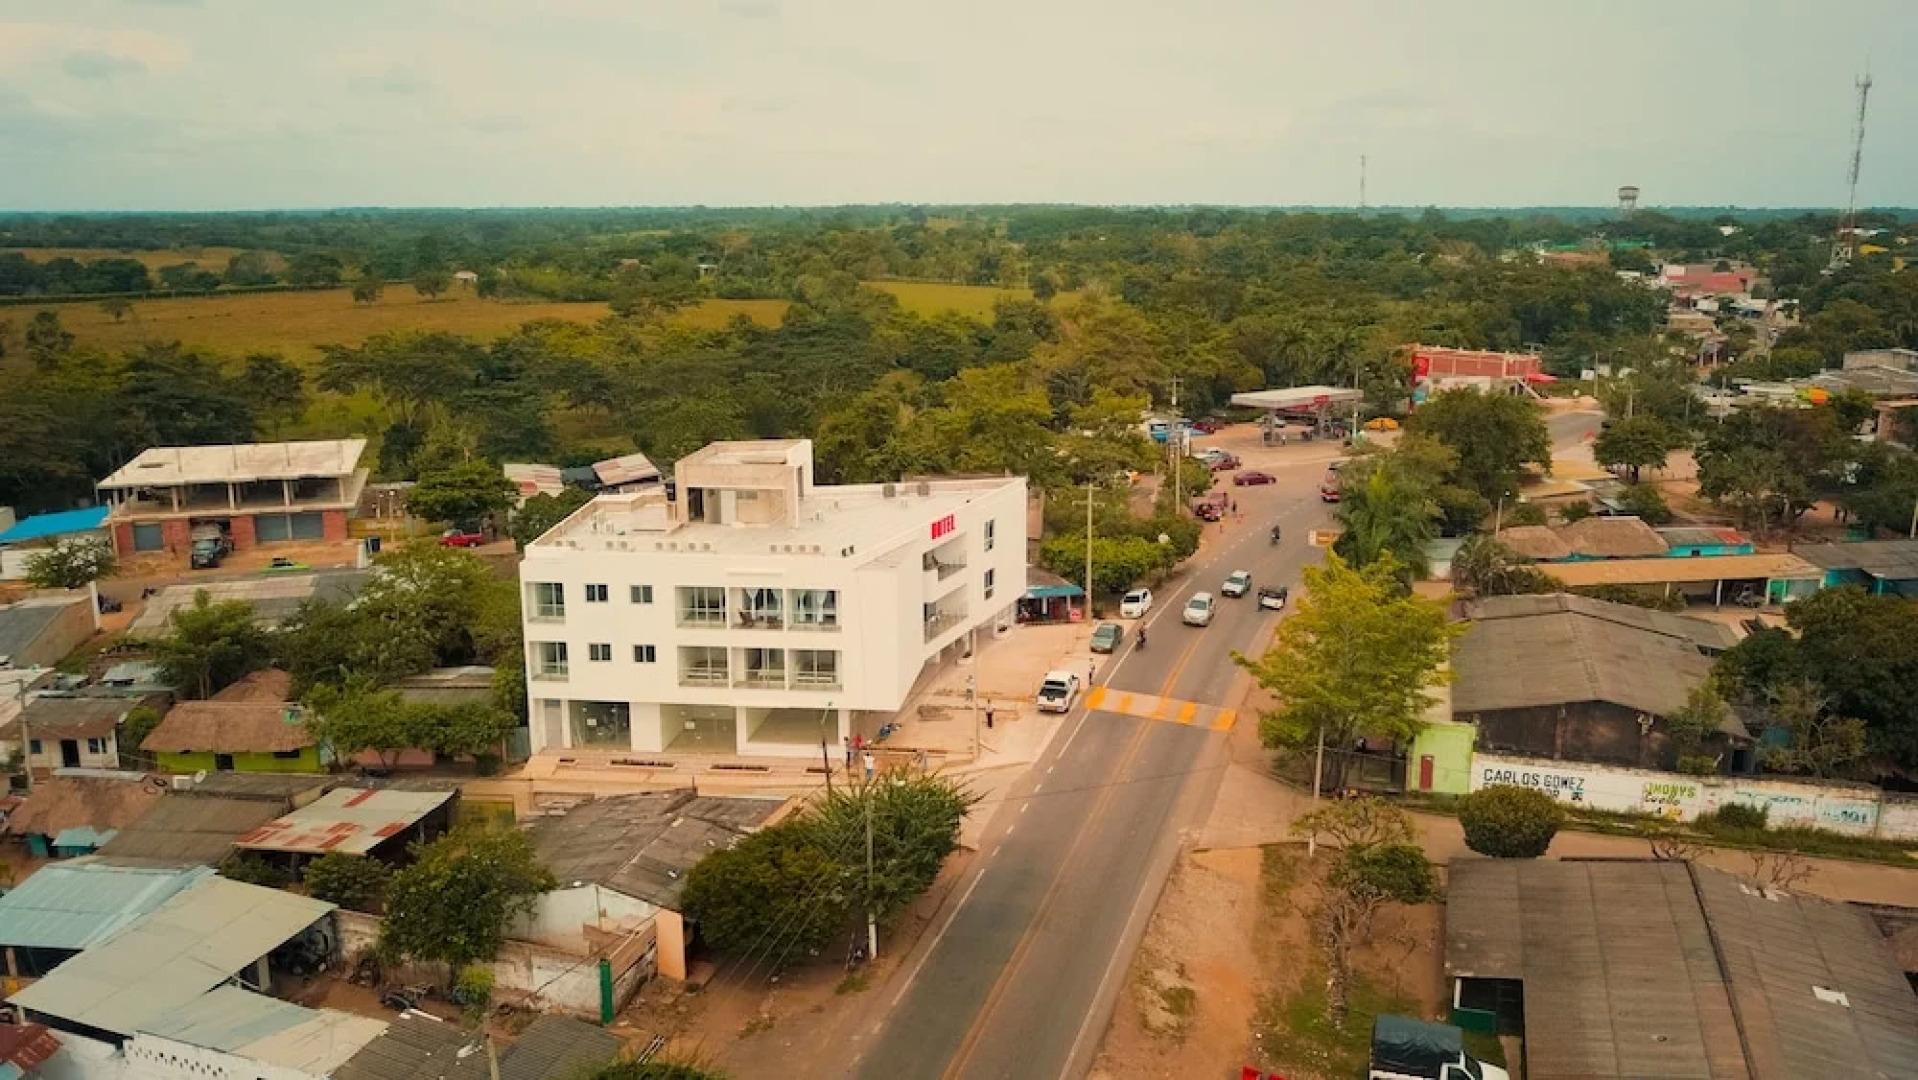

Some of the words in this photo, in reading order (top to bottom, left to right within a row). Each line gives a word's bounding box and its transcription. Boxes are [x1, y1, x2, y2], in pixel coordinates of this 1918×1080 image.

[931, 513, 956, 540] HOTEL
[1484, 768, 1540, 787] CARLOS
[1543, 774, 1585, 791] GOMEZ
